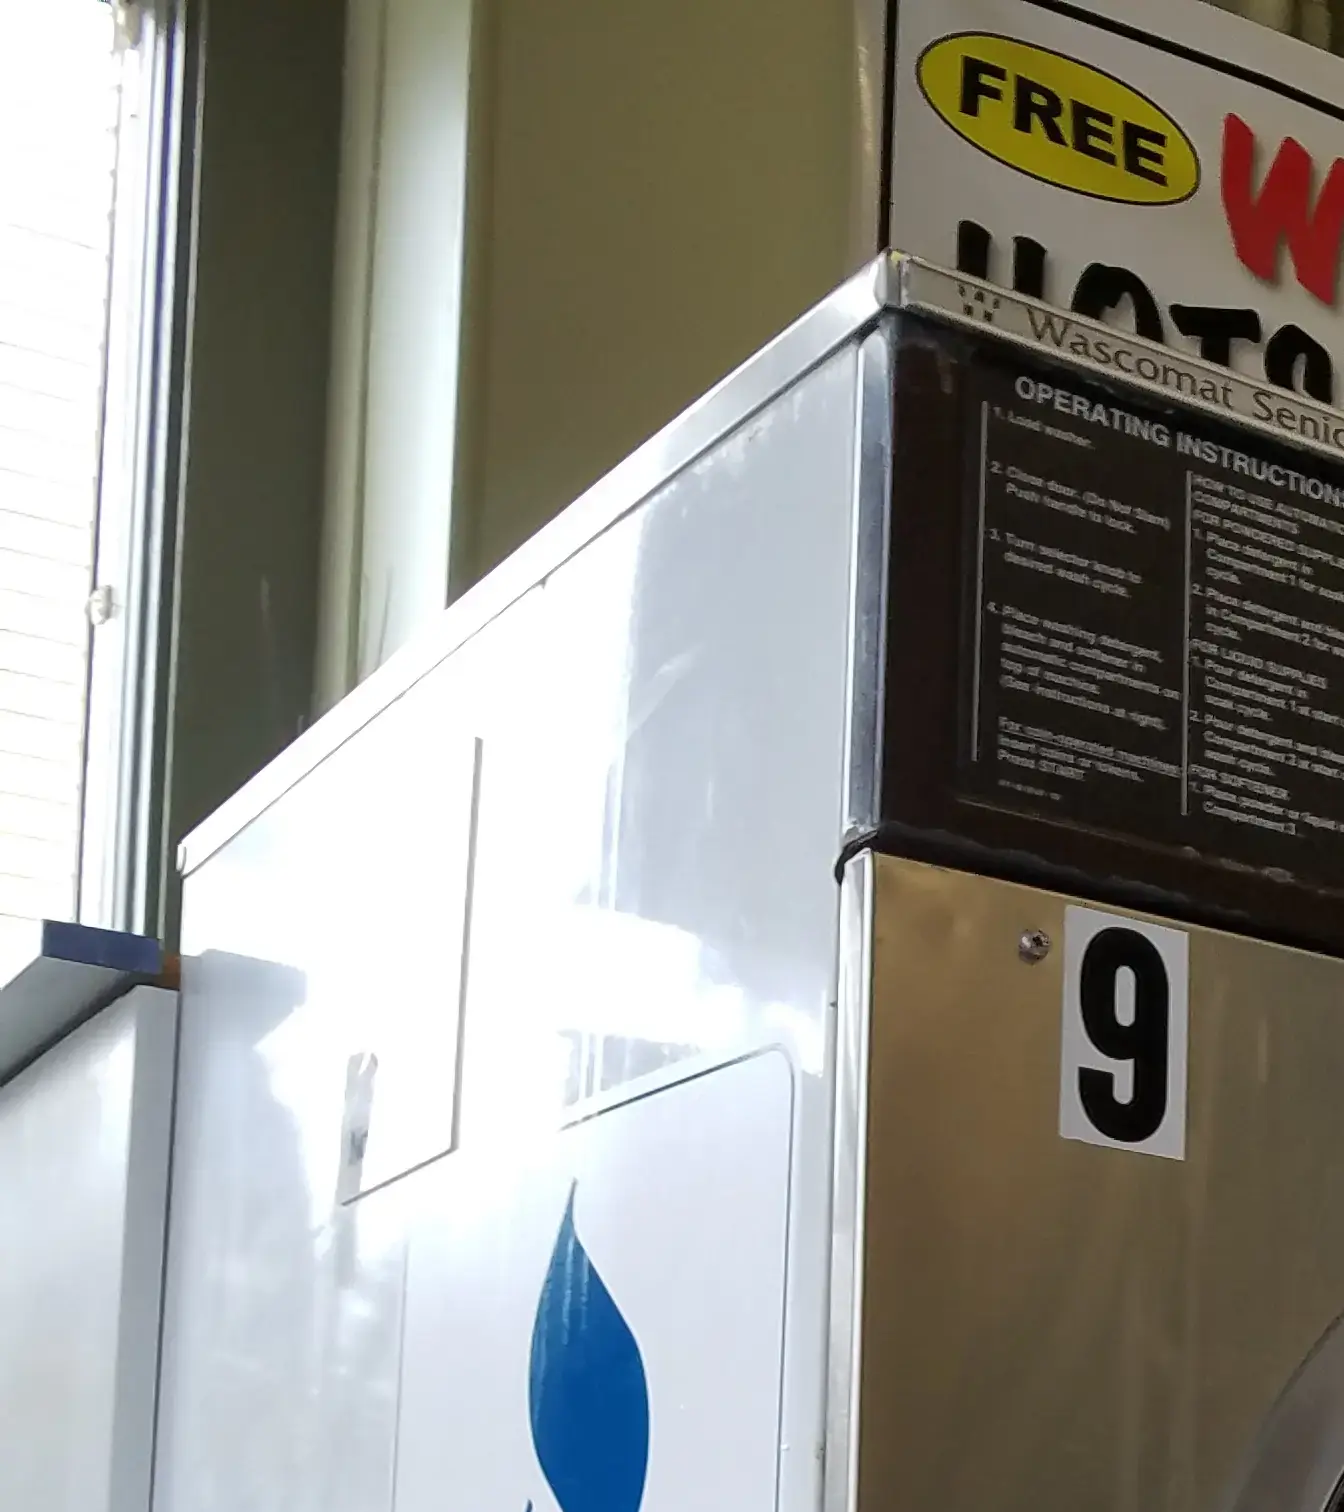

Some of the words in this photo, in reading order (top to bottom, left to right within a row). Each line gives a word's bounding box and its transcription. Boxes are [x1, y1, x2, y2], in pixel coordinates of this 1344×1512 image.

[959, 53, 1170, 189] FREE
[1015, 376, 1170, 449] OPERATING
[1027, 309, 1234, 410] Wascomat
[1078, 927, 1169, 1143] 9
